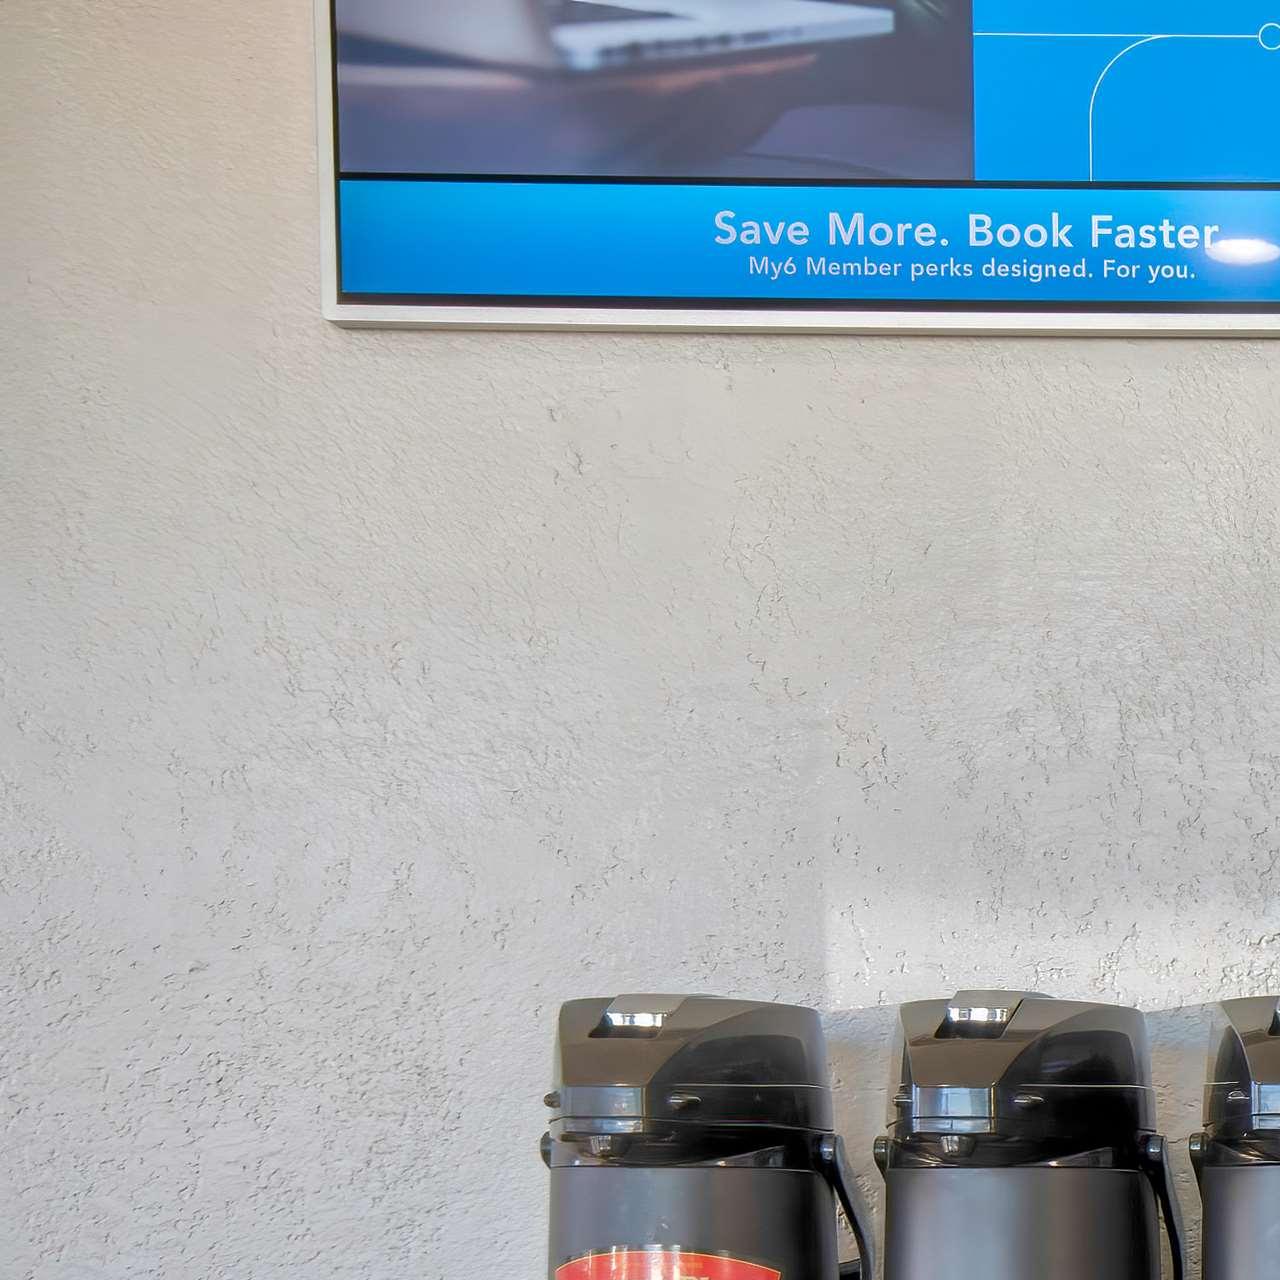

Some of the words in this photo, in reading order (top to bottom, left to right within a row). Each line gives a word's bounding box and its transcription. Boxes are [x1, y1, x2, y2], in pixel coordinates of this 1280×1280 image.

[713, 210, 810, 246] Save
[827, 212, 950, 247] More.
[968, 213, 1074, 249] Book
[1091, 215, 1220, 249] Faster
[748, 255, 797, 279] My6
[805, 257, 903, 278] Member
[910, 258, 974, 282] perks
[981, 259, 1093, 283] designed.
[1103, 260, 1141, 279] For
[1147, 262, 1196, 283] you.
